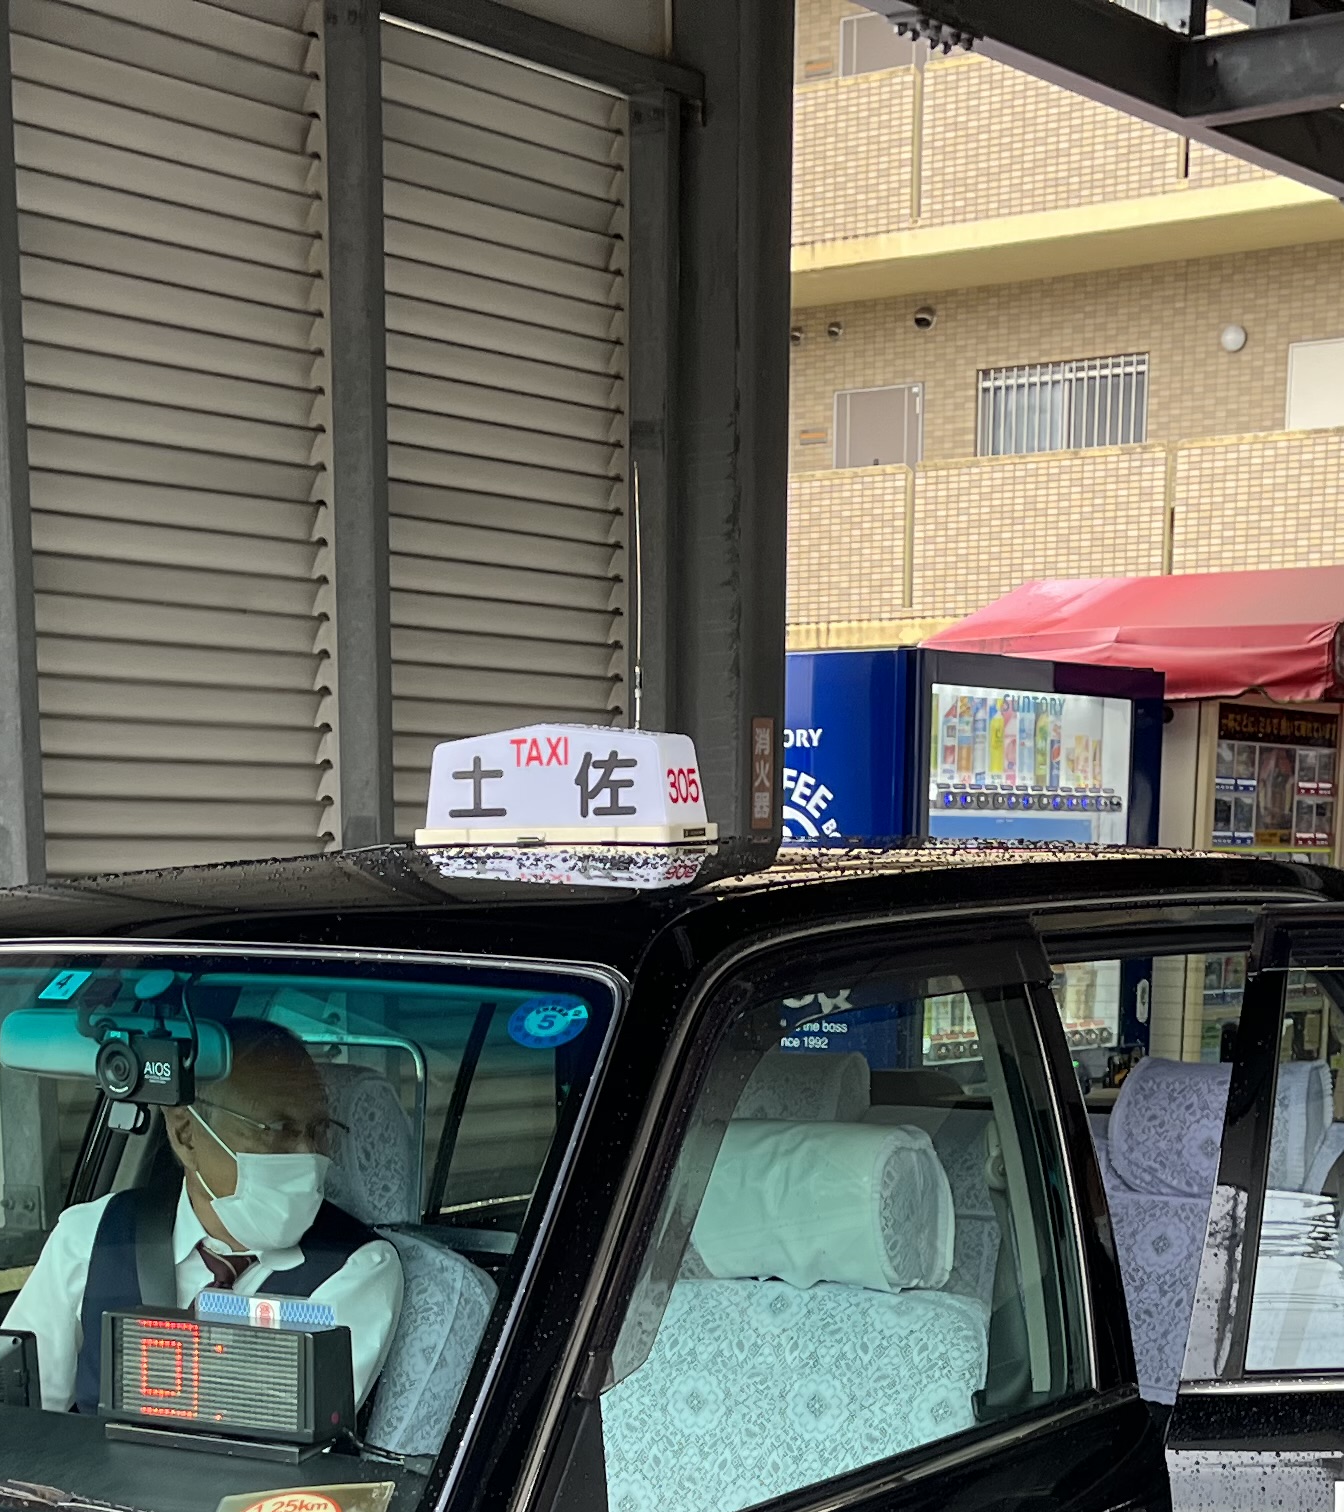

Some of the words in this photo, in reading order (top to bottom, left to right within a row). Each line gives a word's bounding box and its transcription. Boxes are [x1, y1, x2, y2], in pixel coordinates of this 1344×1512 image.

[1003, 693, 1065, 716] SUNTORY
[509, 736, 569, 768] TAXI
[754, 727, 771, 819] 消火器
[666, 768, 699, 803] 305
[537, 1013, 558, 1031] 5
[822, 1019, 848, 1033] boss
[803, 1036, 829, 1049] 1992
[143, 1061, 172, 1077] AIOS
